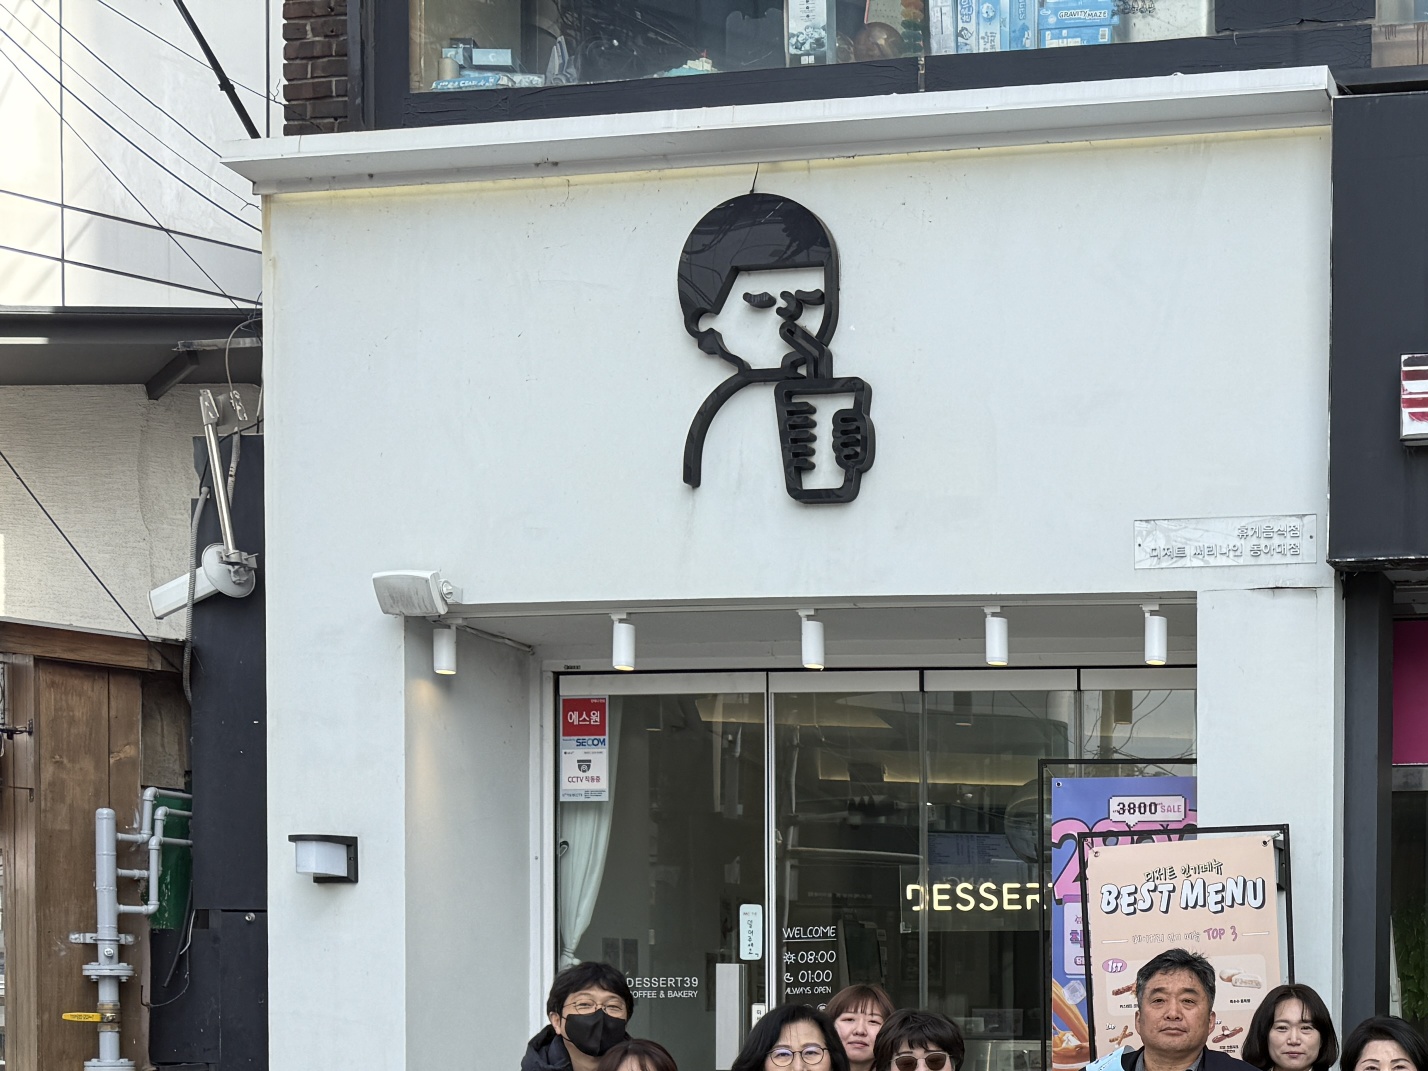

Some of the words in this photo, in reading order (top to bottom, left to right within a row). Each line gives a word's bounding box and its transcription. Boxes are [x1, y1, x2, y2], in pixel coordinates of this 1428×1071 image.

[1058, 10, 1087, 20] GRAVITY
[1087, 9, 1107, 19] MAZE
[1237, 524, 1300, 539] 휴게음식점
[1193, 543, 1243, 558] 써리나인
[1250, 542, 1300, 557] 동아대점
[567, 710, 601, 725] 에스원
[576, 738, 606, 747] SECOM
[1117, 802, 1157, 815] 3800
[1161, 805, 1182, 813] SALE
[906, 882, 1053, 912] DESSER
[1100, 881, 1176, 916] BEST
[1180, 876, 1266, 915] MENU
[783, 926, 836, 938] WELCOME
[1203, 928, 1225, 940] TOP
[1230, 925, 1237, 941] 3
[798, 950, 836, 964] 08:00
[1107, 960, 1123, 972] 1ST
[626, 977, 699, 988] DESSERT39
[798, 970, 832, 983] 01:00
[630, 990, 657, 998] OFFEE
[659, 990, 665, 998] &
[667, 990, 698, 998] BAKERY
[784, 987, 811, 995] ALWAYS
[814, 986, 832, 994] OPEN
